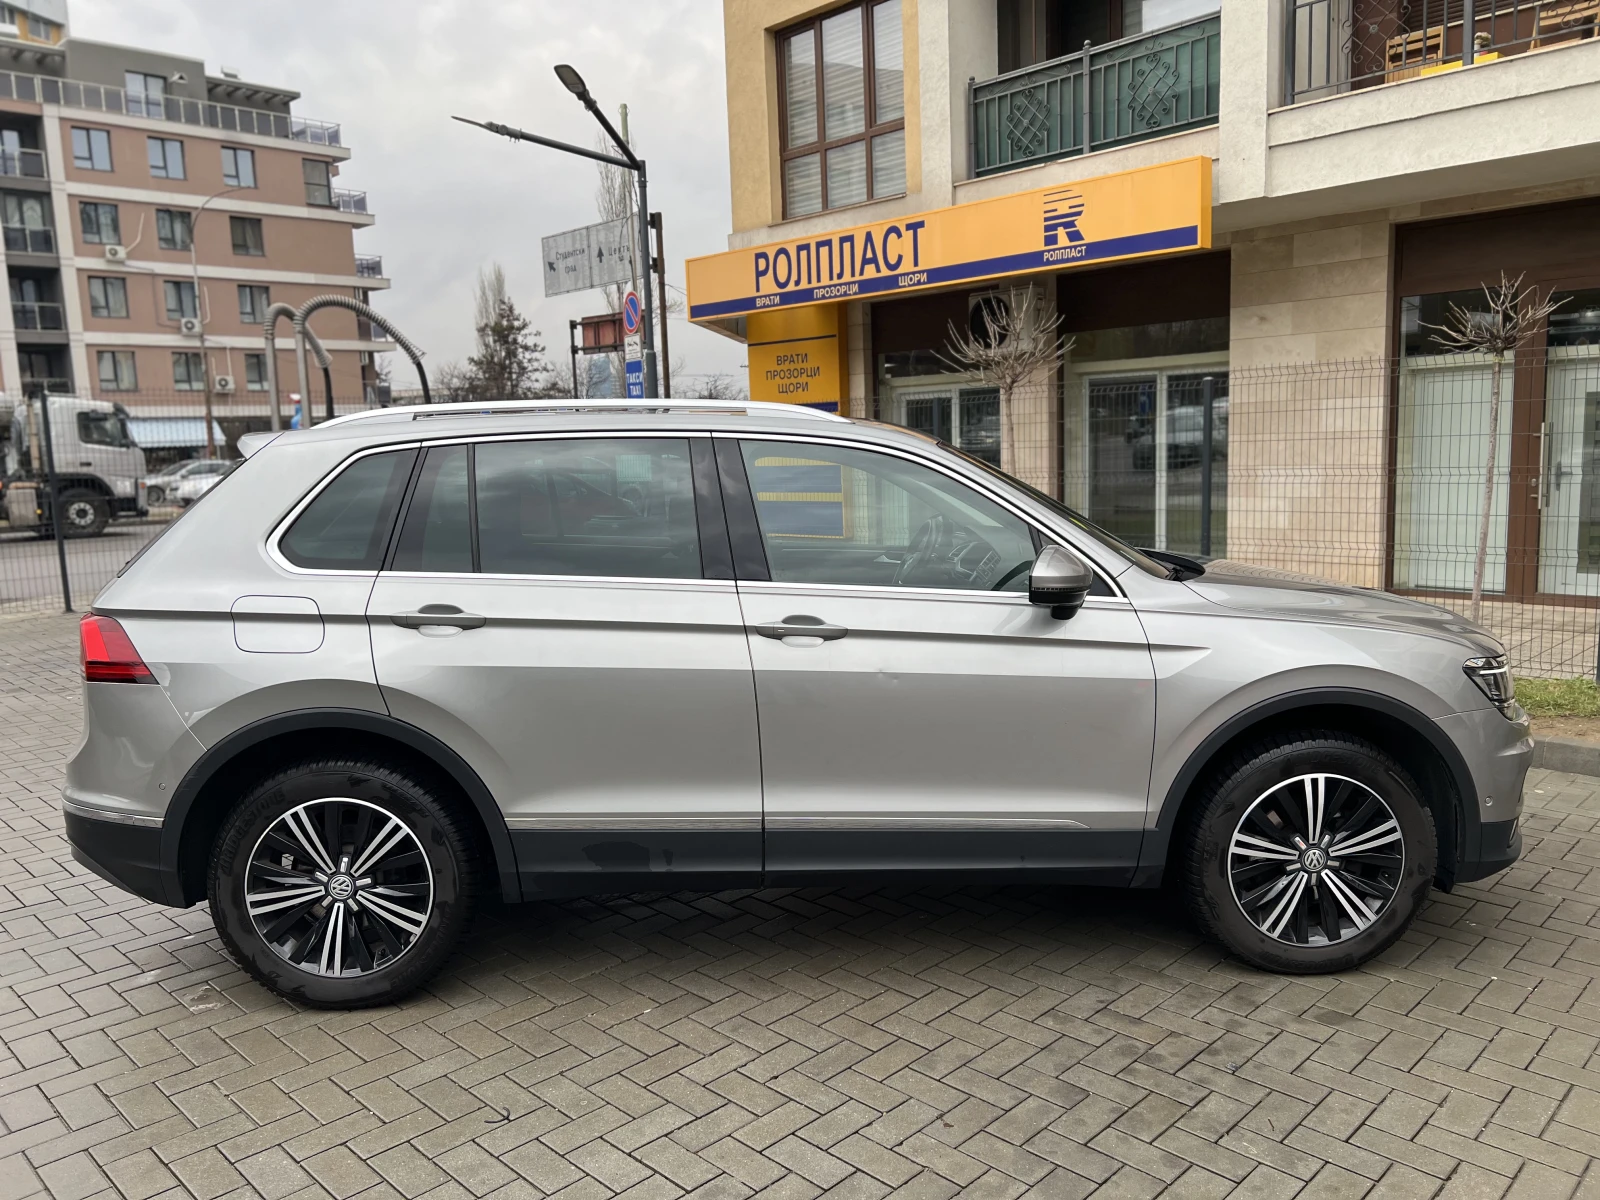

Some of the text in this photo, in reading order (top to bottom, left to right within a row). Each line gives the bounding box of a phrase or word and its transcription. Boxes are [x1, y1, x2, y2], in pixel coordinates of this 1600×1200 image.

[754, 220, 926, 293] РОЛПЛАСТ
[1043, 246, 1087, 262] РОЛПЛАСТ
[756, 272, 927, 307] ВРАТИ ПРОЗОРЦИ ЩОРИ
[776, 352, 808, 366] ВРАТИ
[765, 366, 820, 381] ПРОЗОРЦИ
[629, 384, 642, 396] TAXI
[777, 382, 809, 395] ЩОРИ
